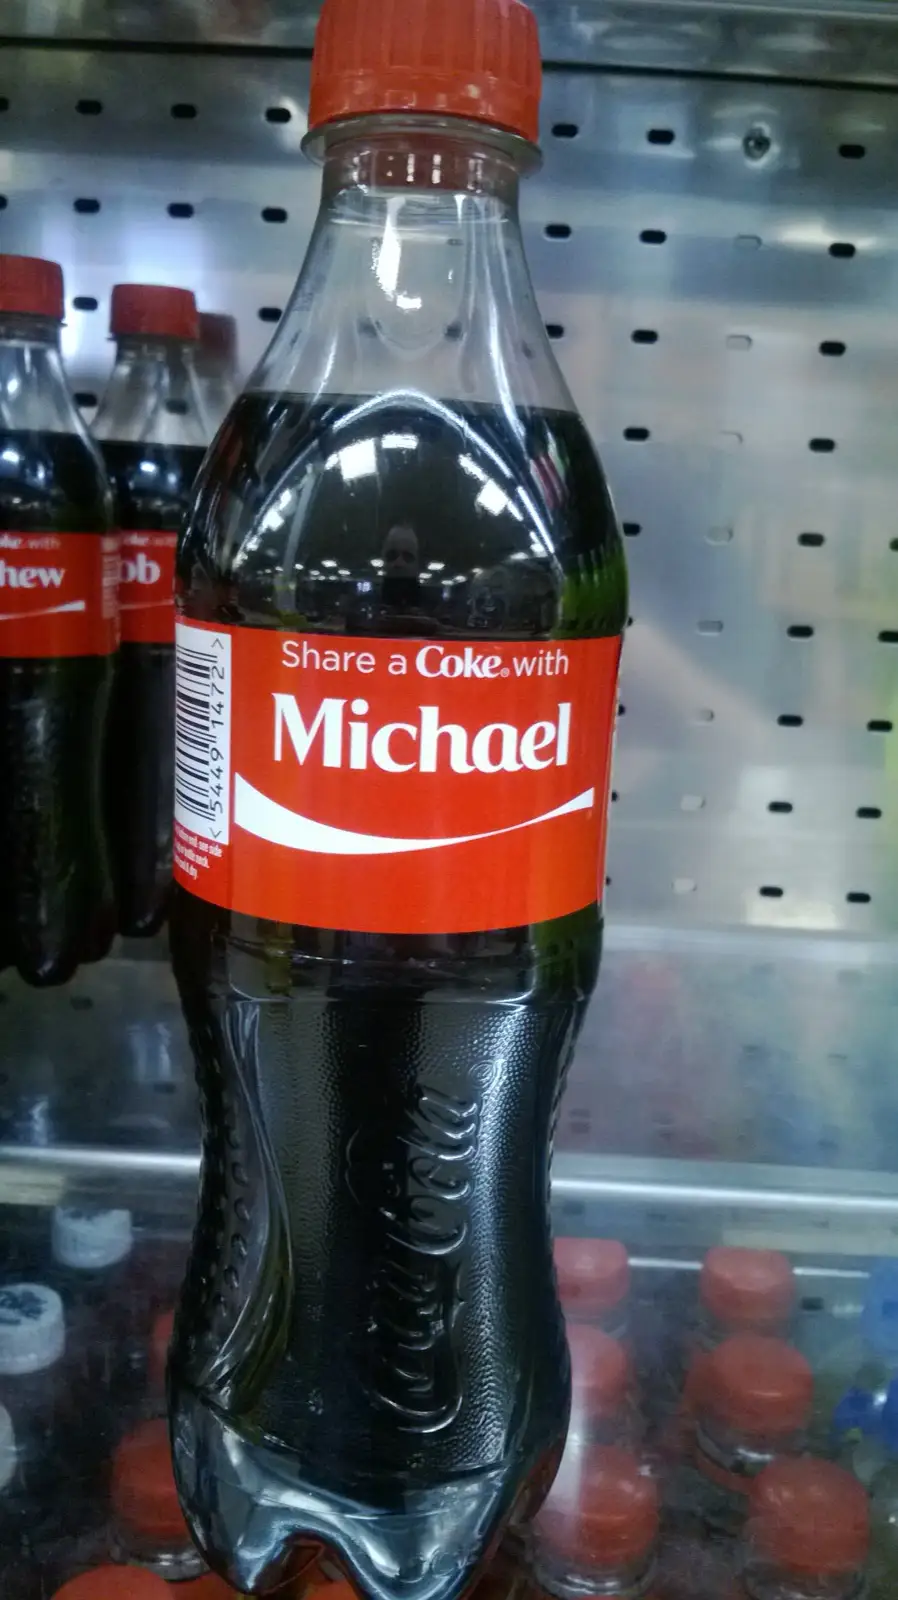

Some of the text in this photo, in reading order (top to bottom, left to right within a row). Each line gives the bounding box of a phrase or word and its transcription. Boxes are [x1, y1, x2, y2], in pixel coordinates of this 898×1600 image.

[0, 560, 65, 588] hew
[281, 639, 376, 673] Share
[387, 653, 407, 675] a
[512, 649, 569, 677] with
[271, 692, 572, 774] Michael
